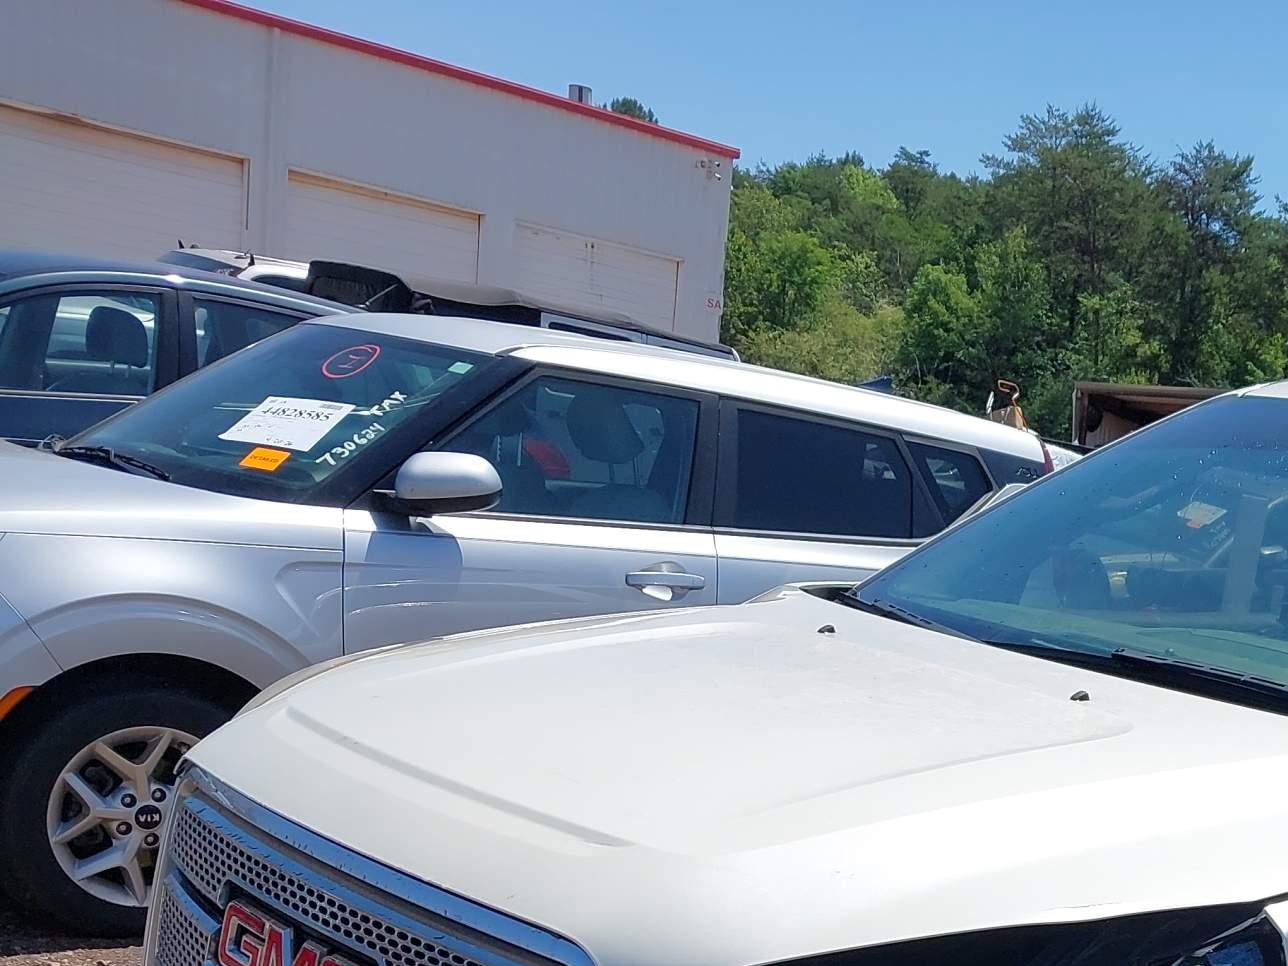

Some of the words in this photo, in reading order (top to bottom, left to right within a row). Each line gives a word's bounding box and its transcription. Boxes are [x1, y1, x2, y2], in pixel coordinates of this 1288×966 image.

[261, 406, 334, 421] 44828585
[315, 422, 386, 466] 730624
[139, 813, 160, 821] KIA
